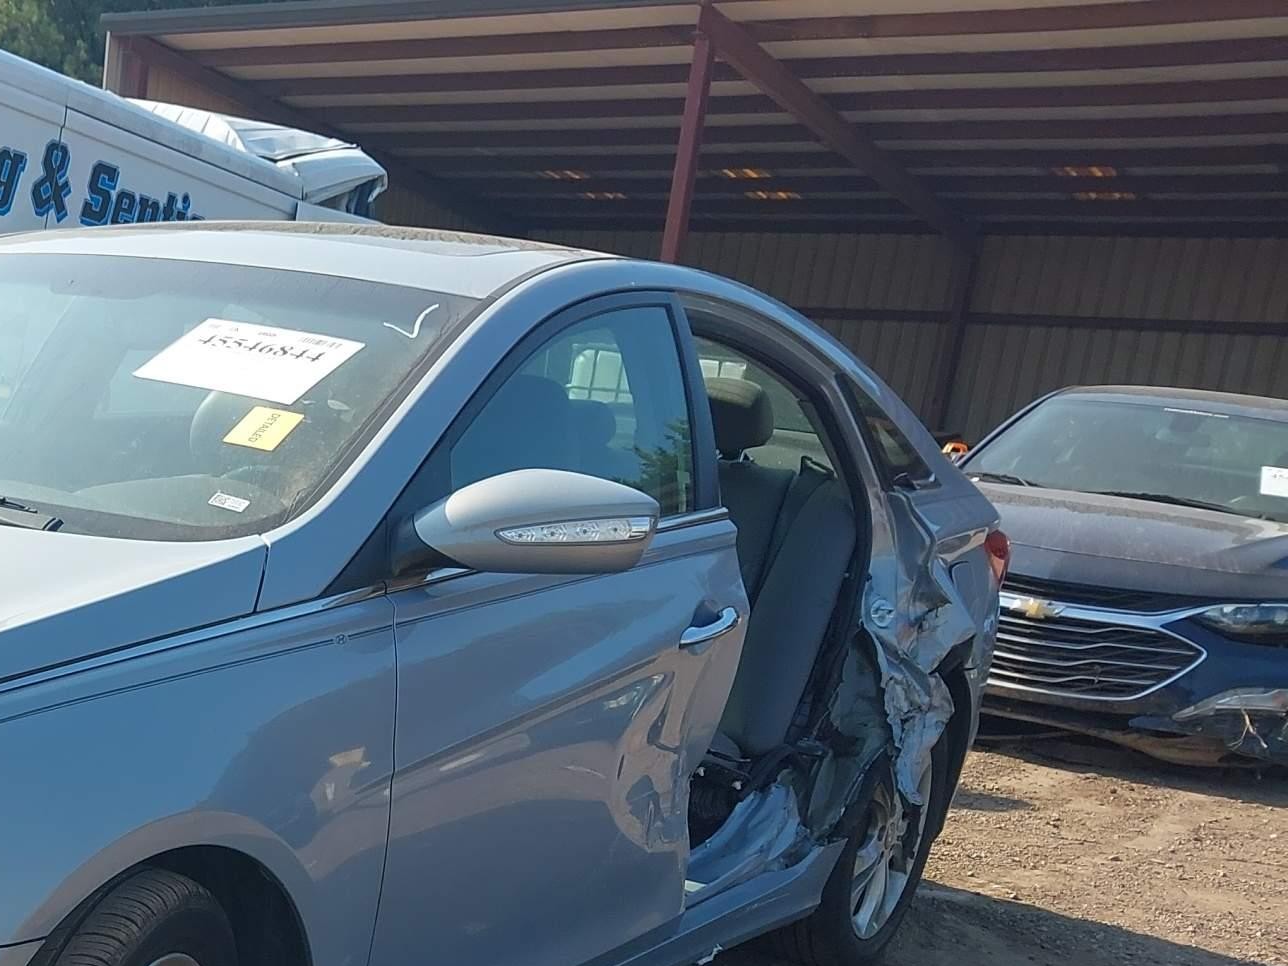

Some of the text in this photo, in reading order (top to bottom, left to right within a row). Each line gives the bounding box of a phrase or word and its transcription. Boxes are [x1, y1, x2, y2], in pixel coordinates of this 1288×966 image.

[31, 138, 72, 224] &
[80, 160, 208, 228] Septi
[247, 412, 282, 444] DETAILED
